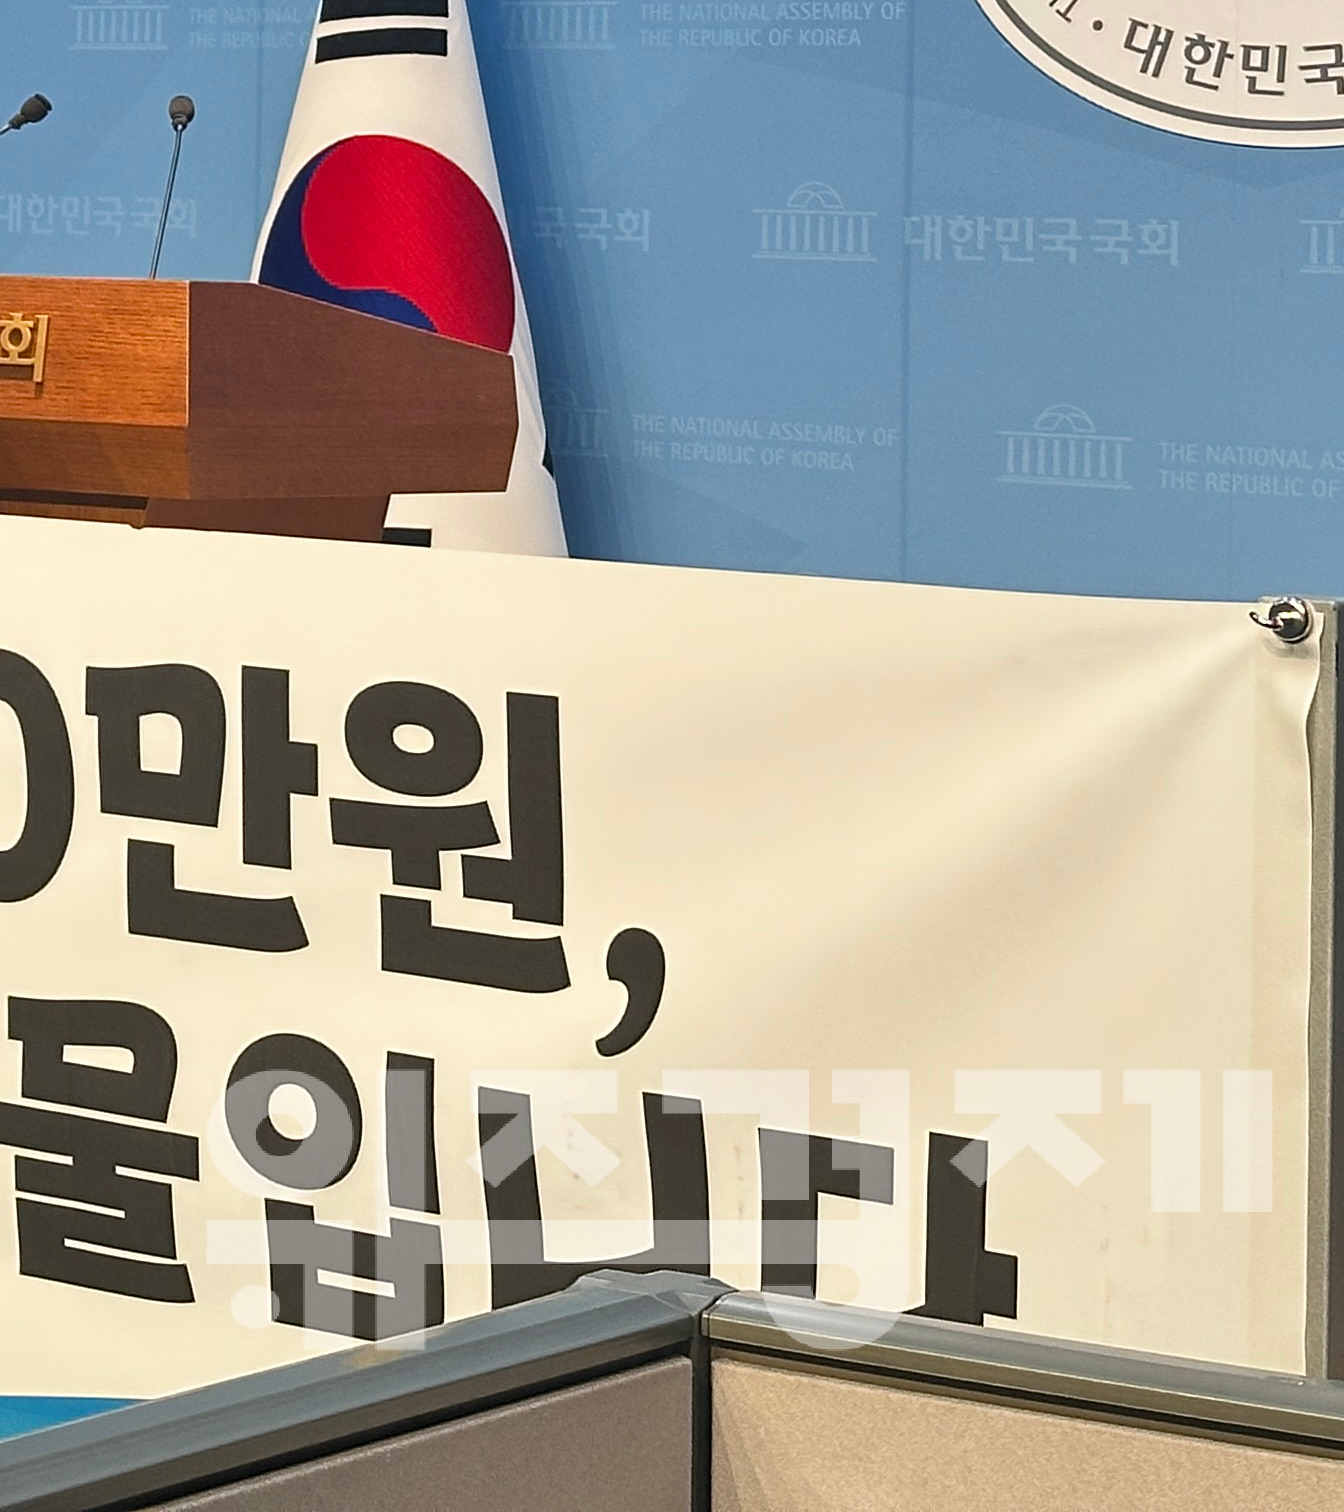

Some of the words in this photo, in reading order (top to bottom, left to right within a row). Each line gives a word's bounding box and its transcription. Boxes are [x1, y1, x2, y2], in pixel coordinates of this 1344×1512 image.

[640, 2, 672, 21] THE
[678, 2, 767, 21] NATIONAL
[776, 1, 873, 21] ASSEMBLY
[880, 0, 906, 20] OF
[639, 29, 671, 47] THE
[678, 29, 762, 47] REPUBLIC
[768, 29, 794, 47] OF
[799, 28, 862, 47] KOREA
[904, 215, 1179, 266] 대한민국국회
[632, 414, 664, 434] THE
[671, 416, 763, 440] NATIONAL
[770, 420, 866, 446] ASSEMBLY
[873, 427, 899, 447] OF
[632, 439, 664, 460] THE
[671, 442, 753, 466] REPUBLIC
[761, 448, 786, 468] OF
[793, 449, 854, 470] KOREA
[1158, 441, 1198, 465] THE
[1206, 443, 1312, 470] NATIONAL
[1158, 467, 1198, 491] THE
[1205, 469, 1305, 498] REPUBLIC
[1312, 477, 1342, 500] OF
